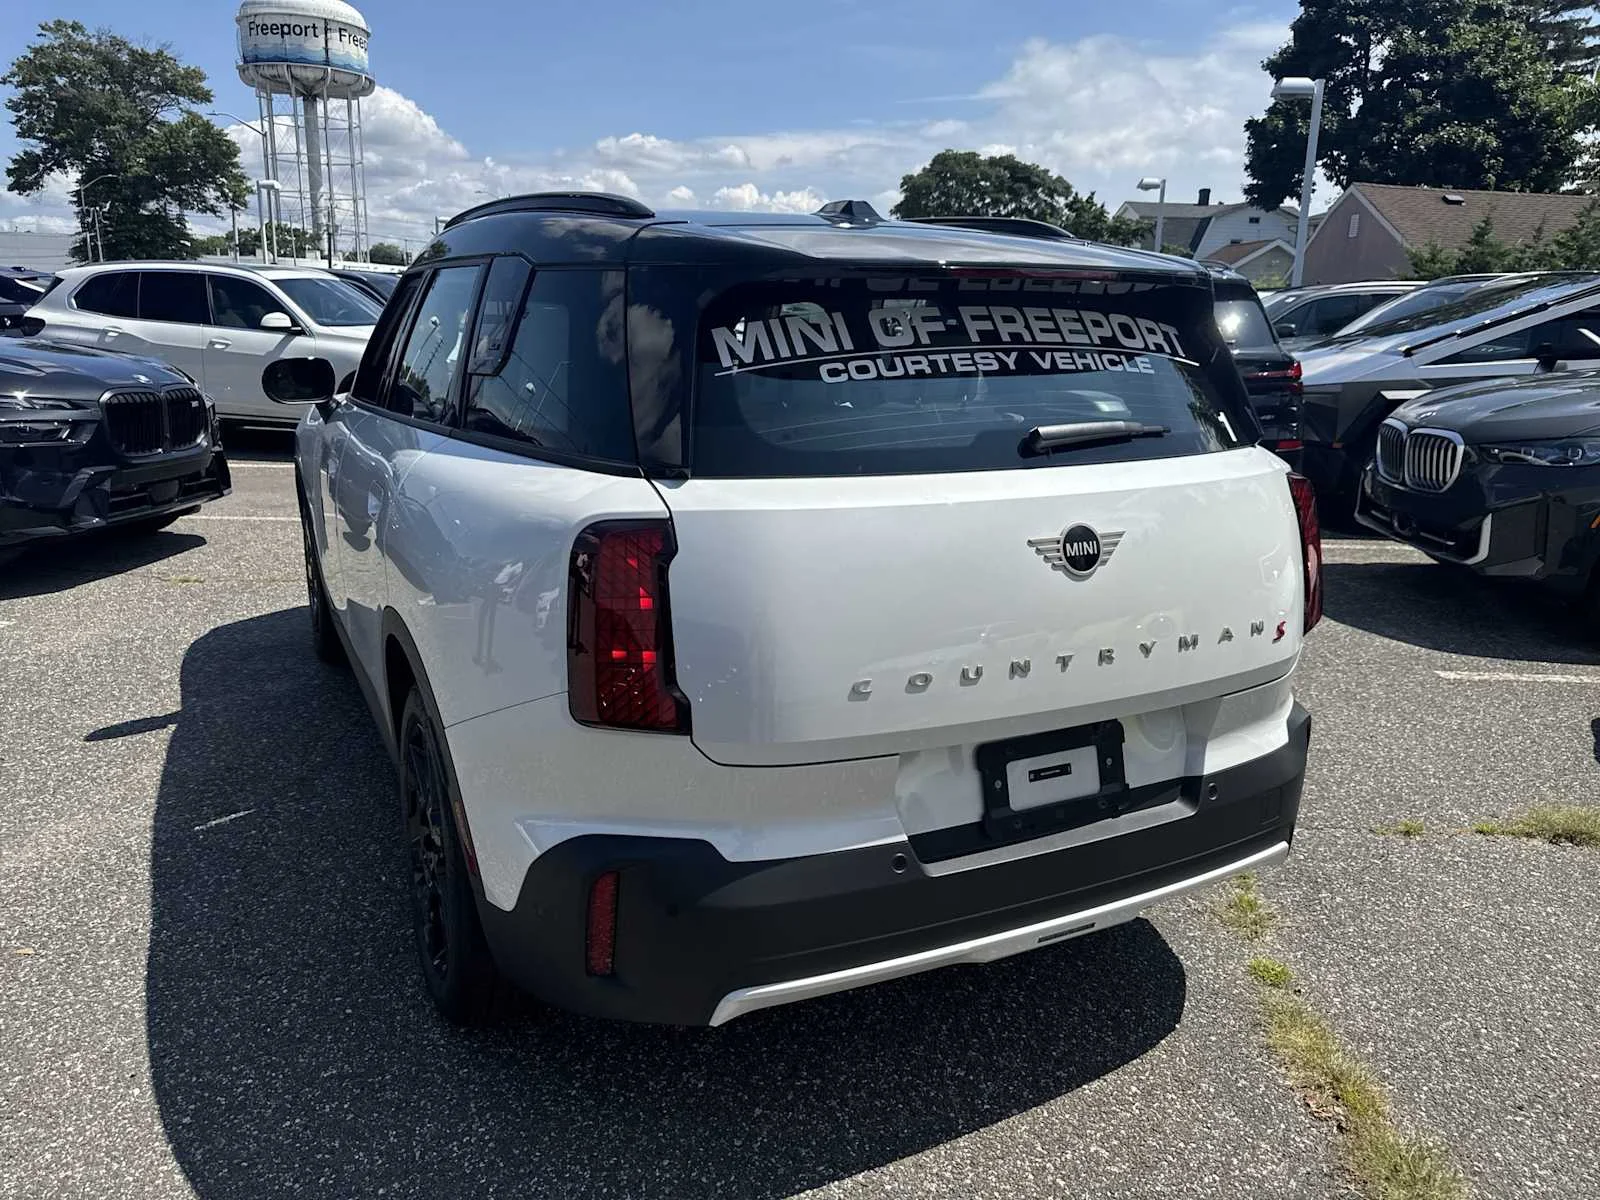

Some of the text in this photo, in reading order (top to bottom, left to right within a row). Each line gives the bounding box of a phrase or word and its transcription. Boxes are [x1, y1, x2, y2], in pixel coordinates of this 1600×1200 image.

[248, 21, 319, 38] Freeport
[711, 306, 1187, 368] MINI OF FREEPORT
[820, 351, 1155, 384] COURTESY VEHICLE
[1065, 540, 1098, 557] MINI
[848, 619, 1287, 698] COUNTRYMAN S
